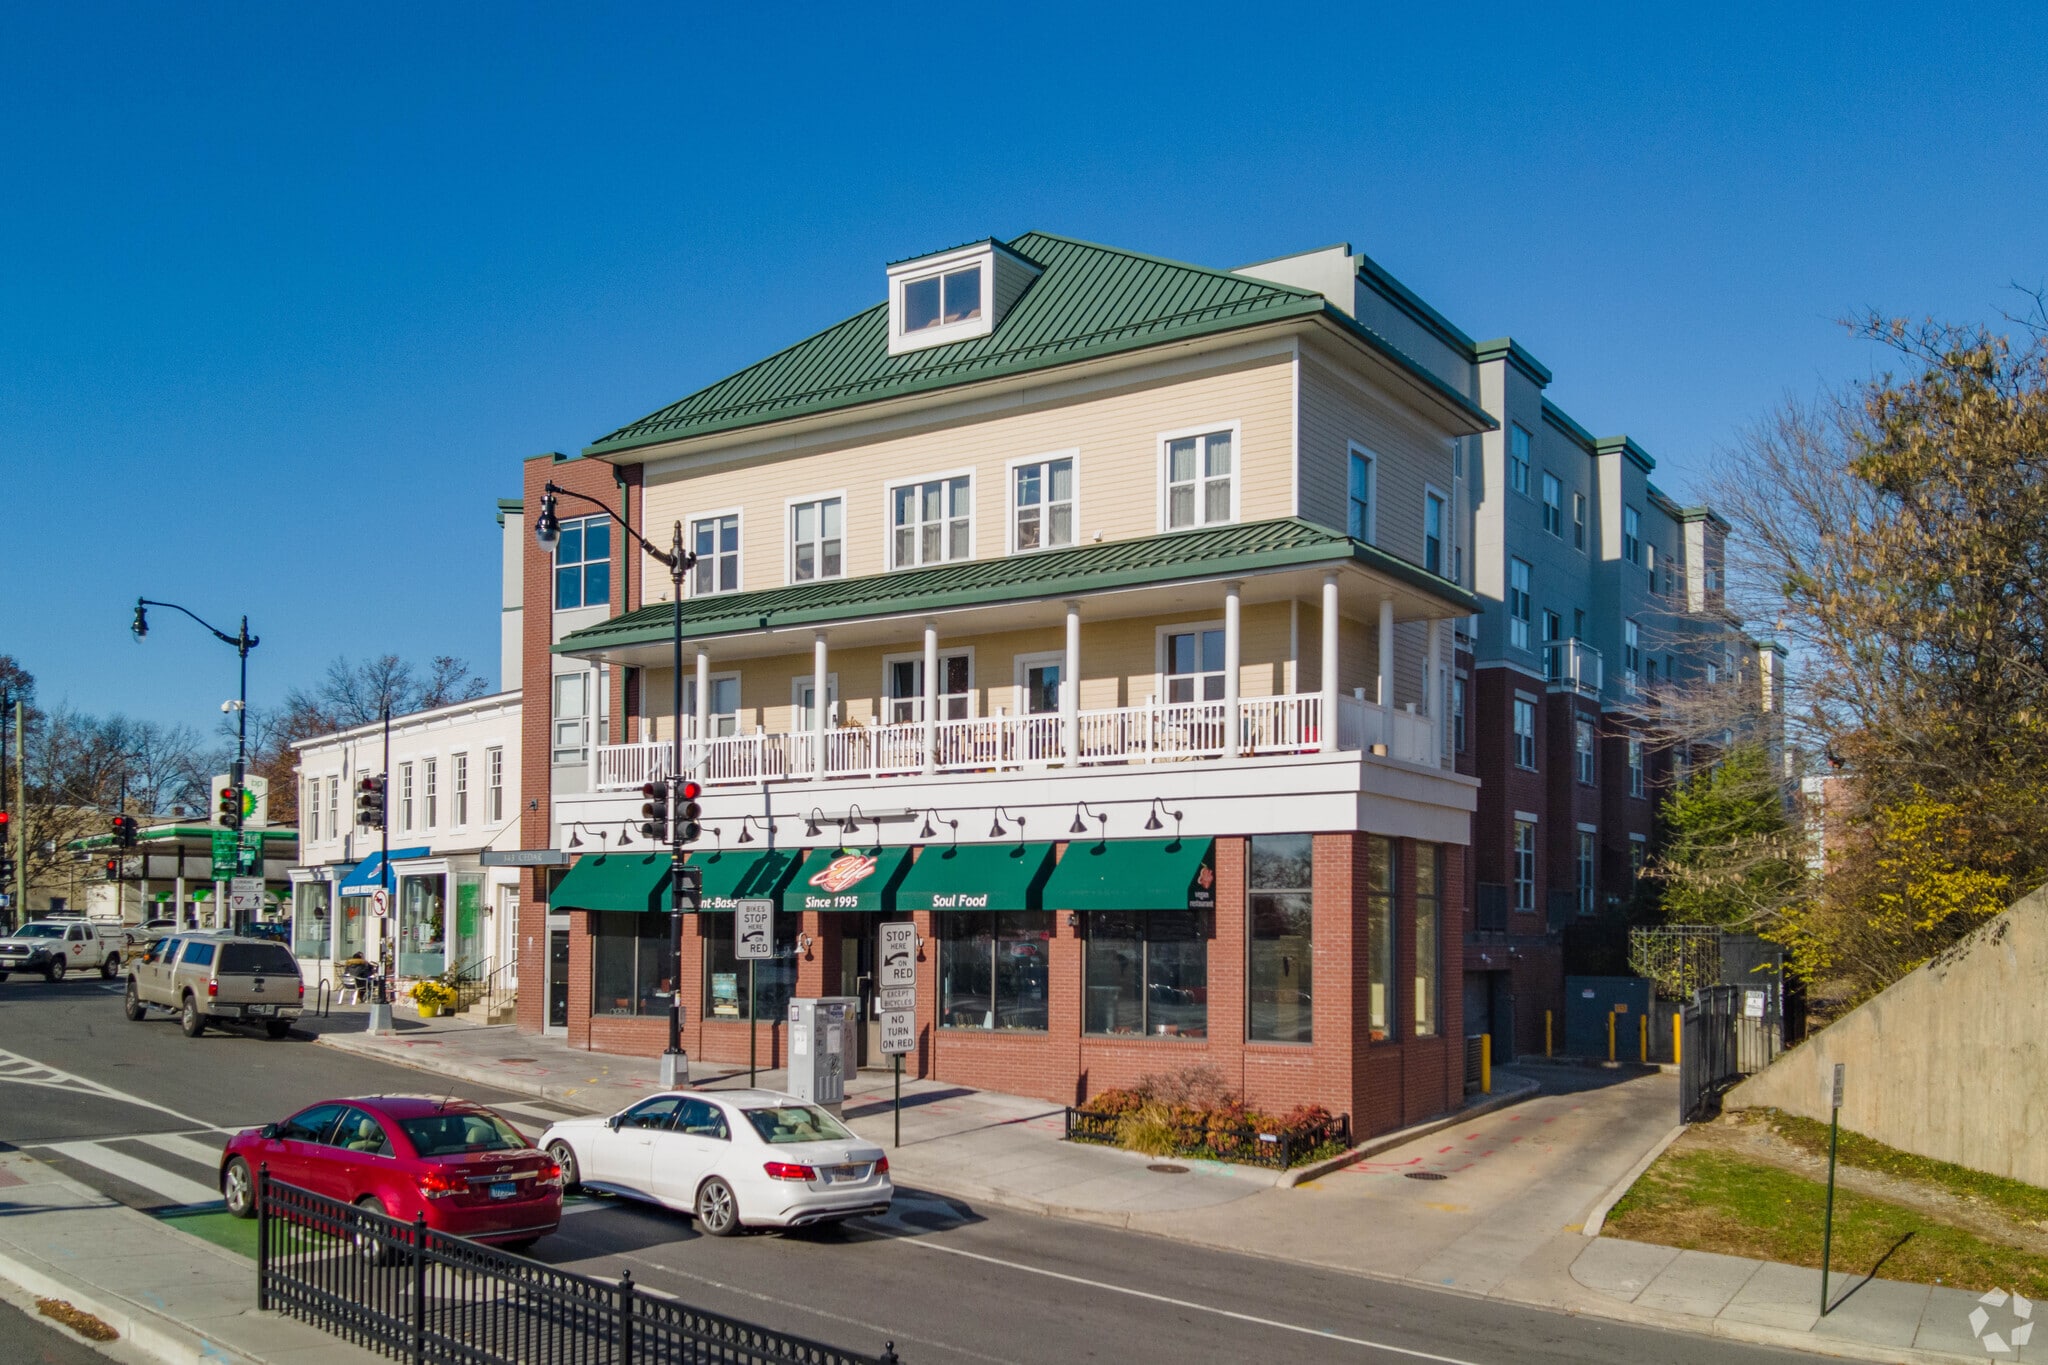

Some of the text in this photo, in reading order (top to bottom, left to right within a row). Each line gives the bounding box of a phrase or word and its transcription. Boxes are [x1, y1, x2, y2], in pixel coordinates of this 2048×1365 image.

[805, 895, 858, 907] Since 1995
[932, 893, 987, 907] Soul Food
[744, 914, 768, 922] STOP
[886, 931, 912, 941] STOP
[750, 944, 768, 953] RED
[893, 968, 913, 979] RED
[891, 1015, 904, 1024] NO
[888, 1027, 909, 1036] TURN
[883, 1038, 913, 1049] ON RED
